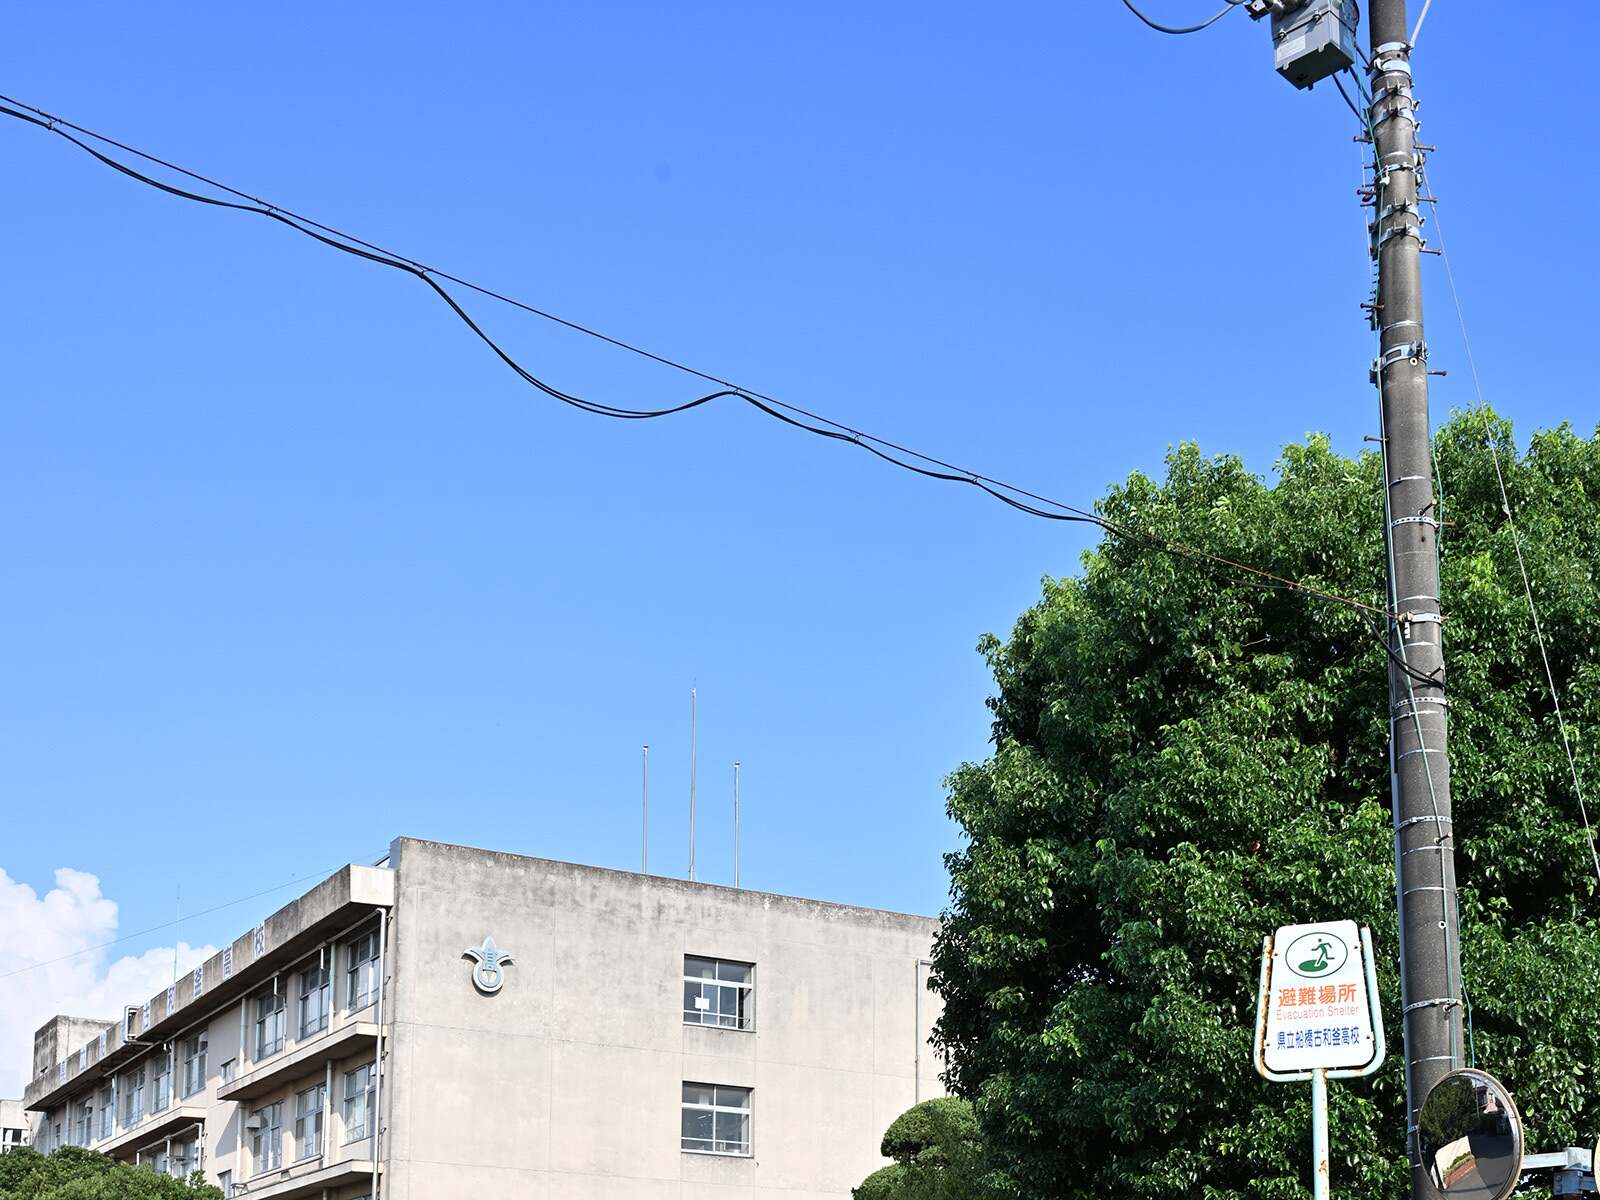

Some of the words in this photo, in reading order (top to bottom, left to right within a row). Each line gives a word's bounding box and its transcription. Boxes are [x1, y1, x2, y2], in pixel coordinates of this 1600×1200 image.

[1278, 983, 1357, 1008] 避難場所
[1277, 1008, 1325, 1021] Evacuation
[1327, 1004, 1359, 1017] Shelter
[1276, 1026, 1360, 1050] 県立船橋古和釜高校
